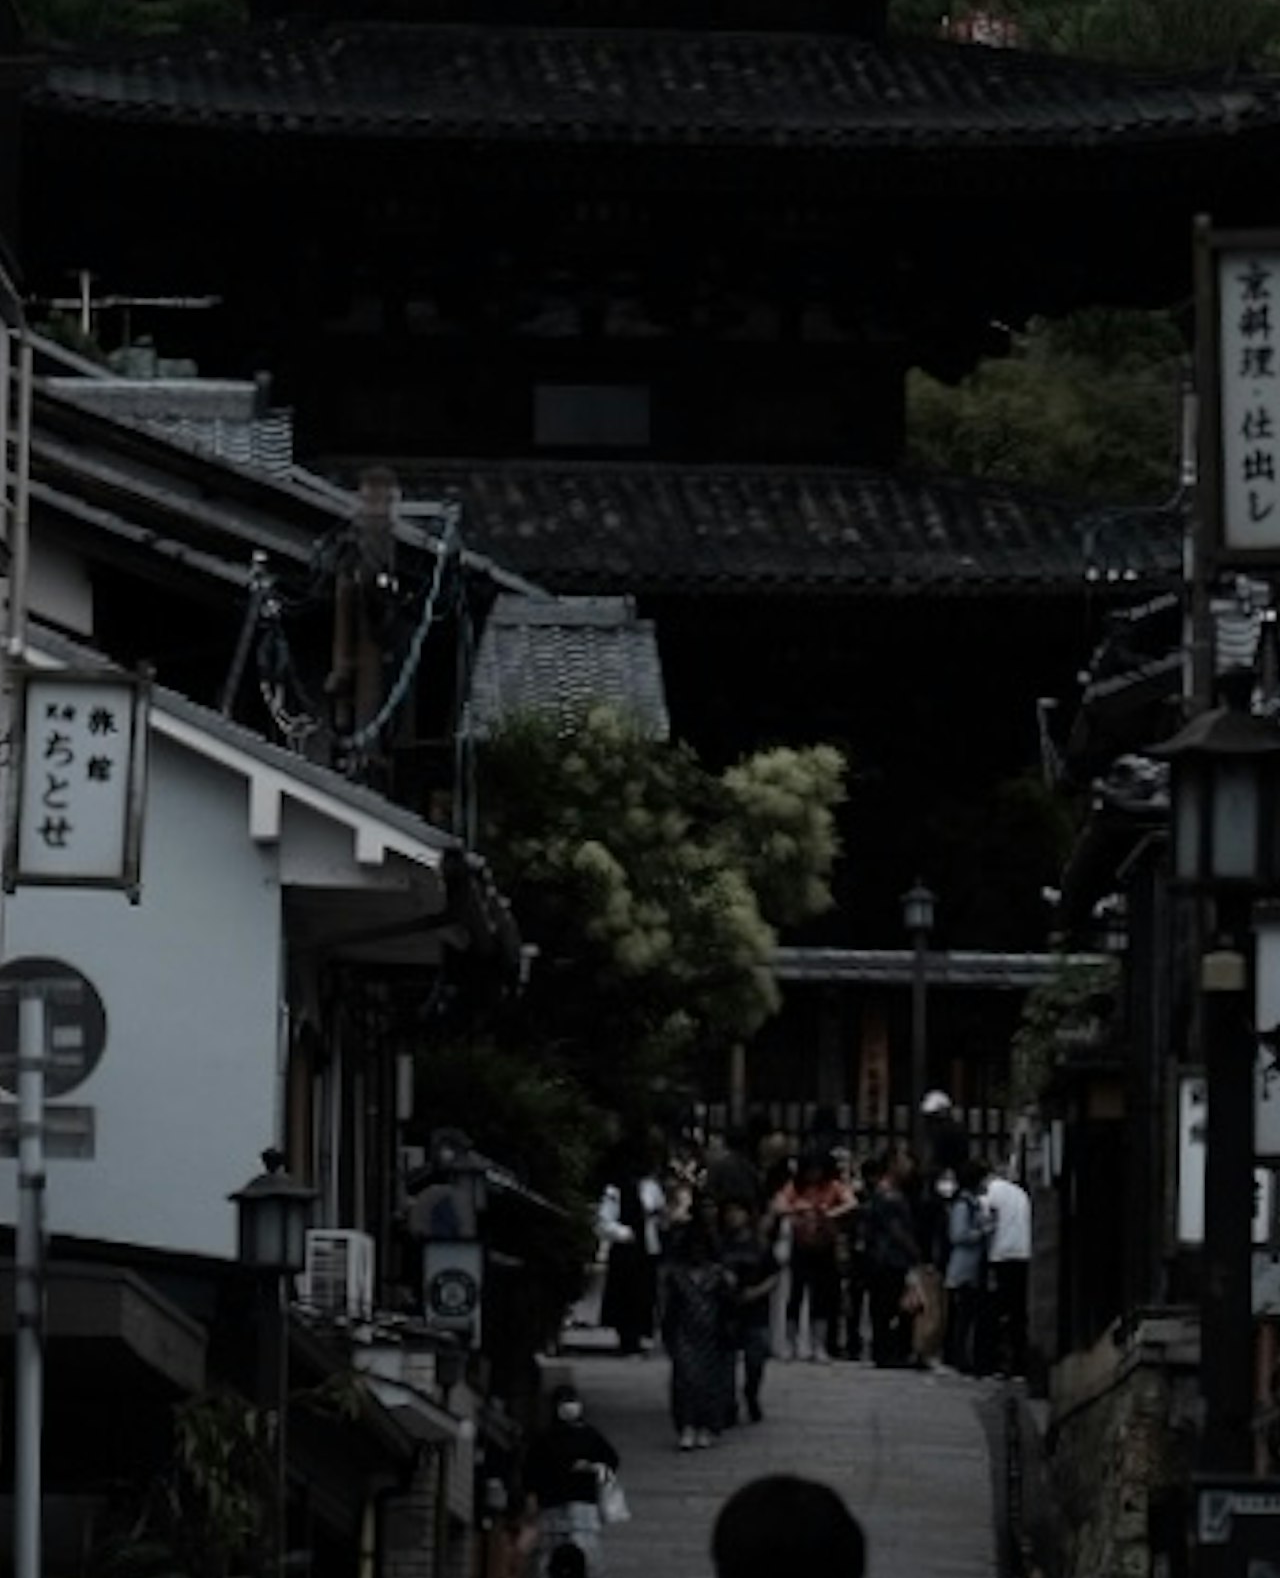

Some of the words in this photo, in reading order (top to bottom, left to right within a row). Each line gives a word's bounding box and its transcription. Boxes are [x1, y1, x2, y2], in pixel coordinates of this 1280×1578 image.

[36, 729, 75, 849] ちとせ
[87, 707, 118, 783] 旅館
